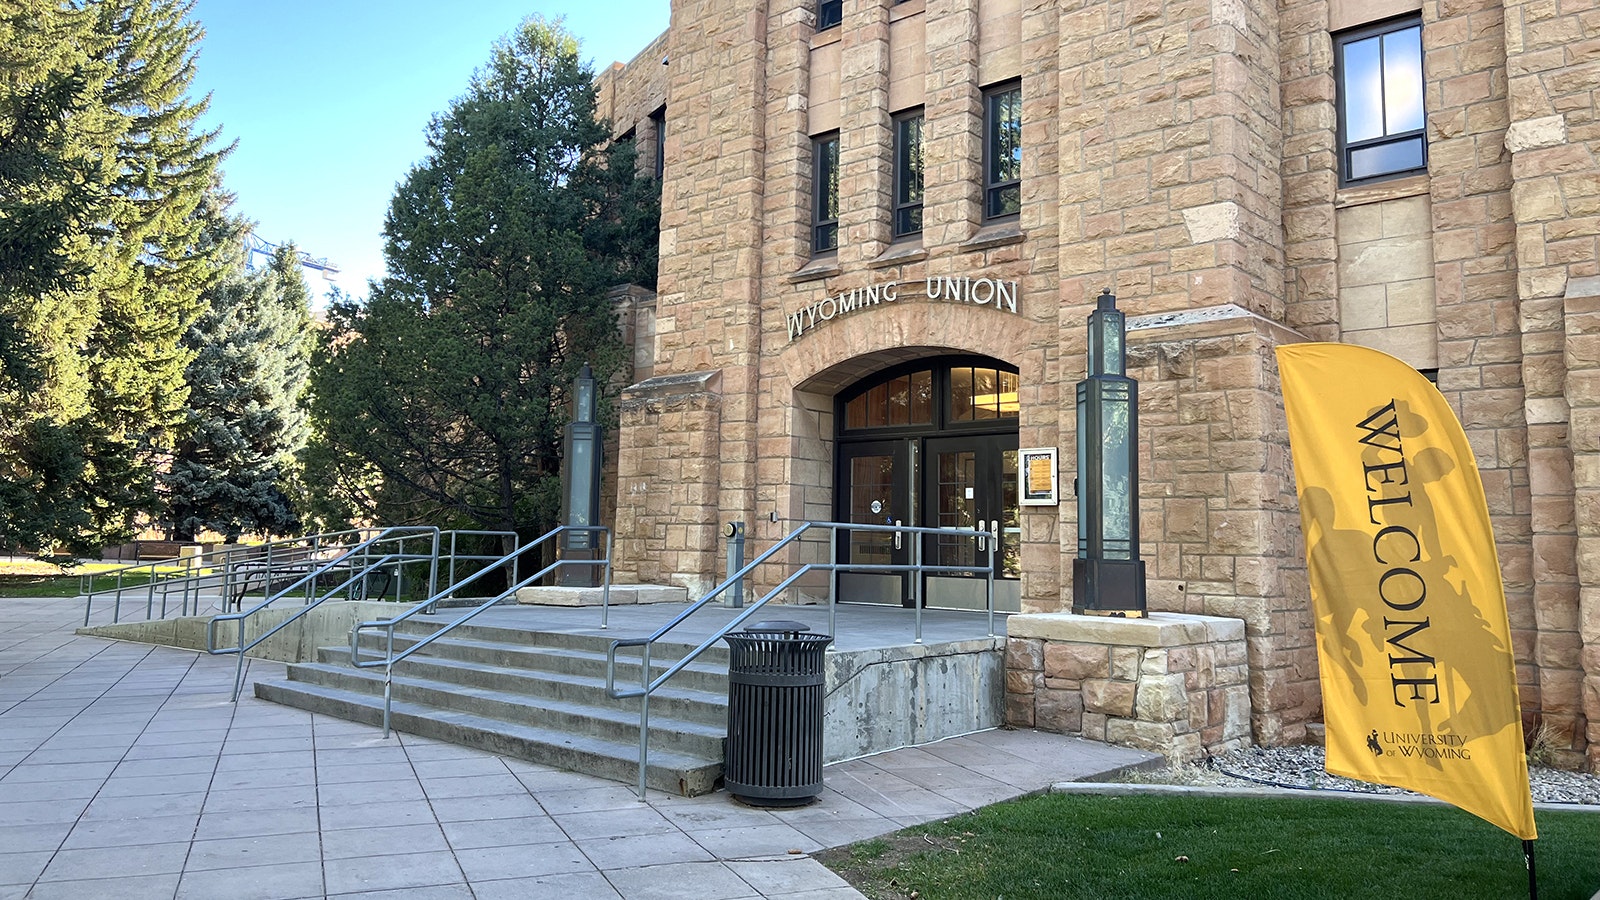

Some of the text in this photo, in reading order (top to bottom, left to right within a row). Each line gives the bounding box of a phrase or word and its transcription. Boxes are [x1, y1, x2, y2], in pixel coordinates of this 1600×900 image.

[787, 276, 1017, 342] WYOMING UNION
[1356, 398, 1441, 708] WELCOME
[1383, 732, 1468, 747] UNIVERSITY
[1398, 745, 1471, 760] WYOMING
